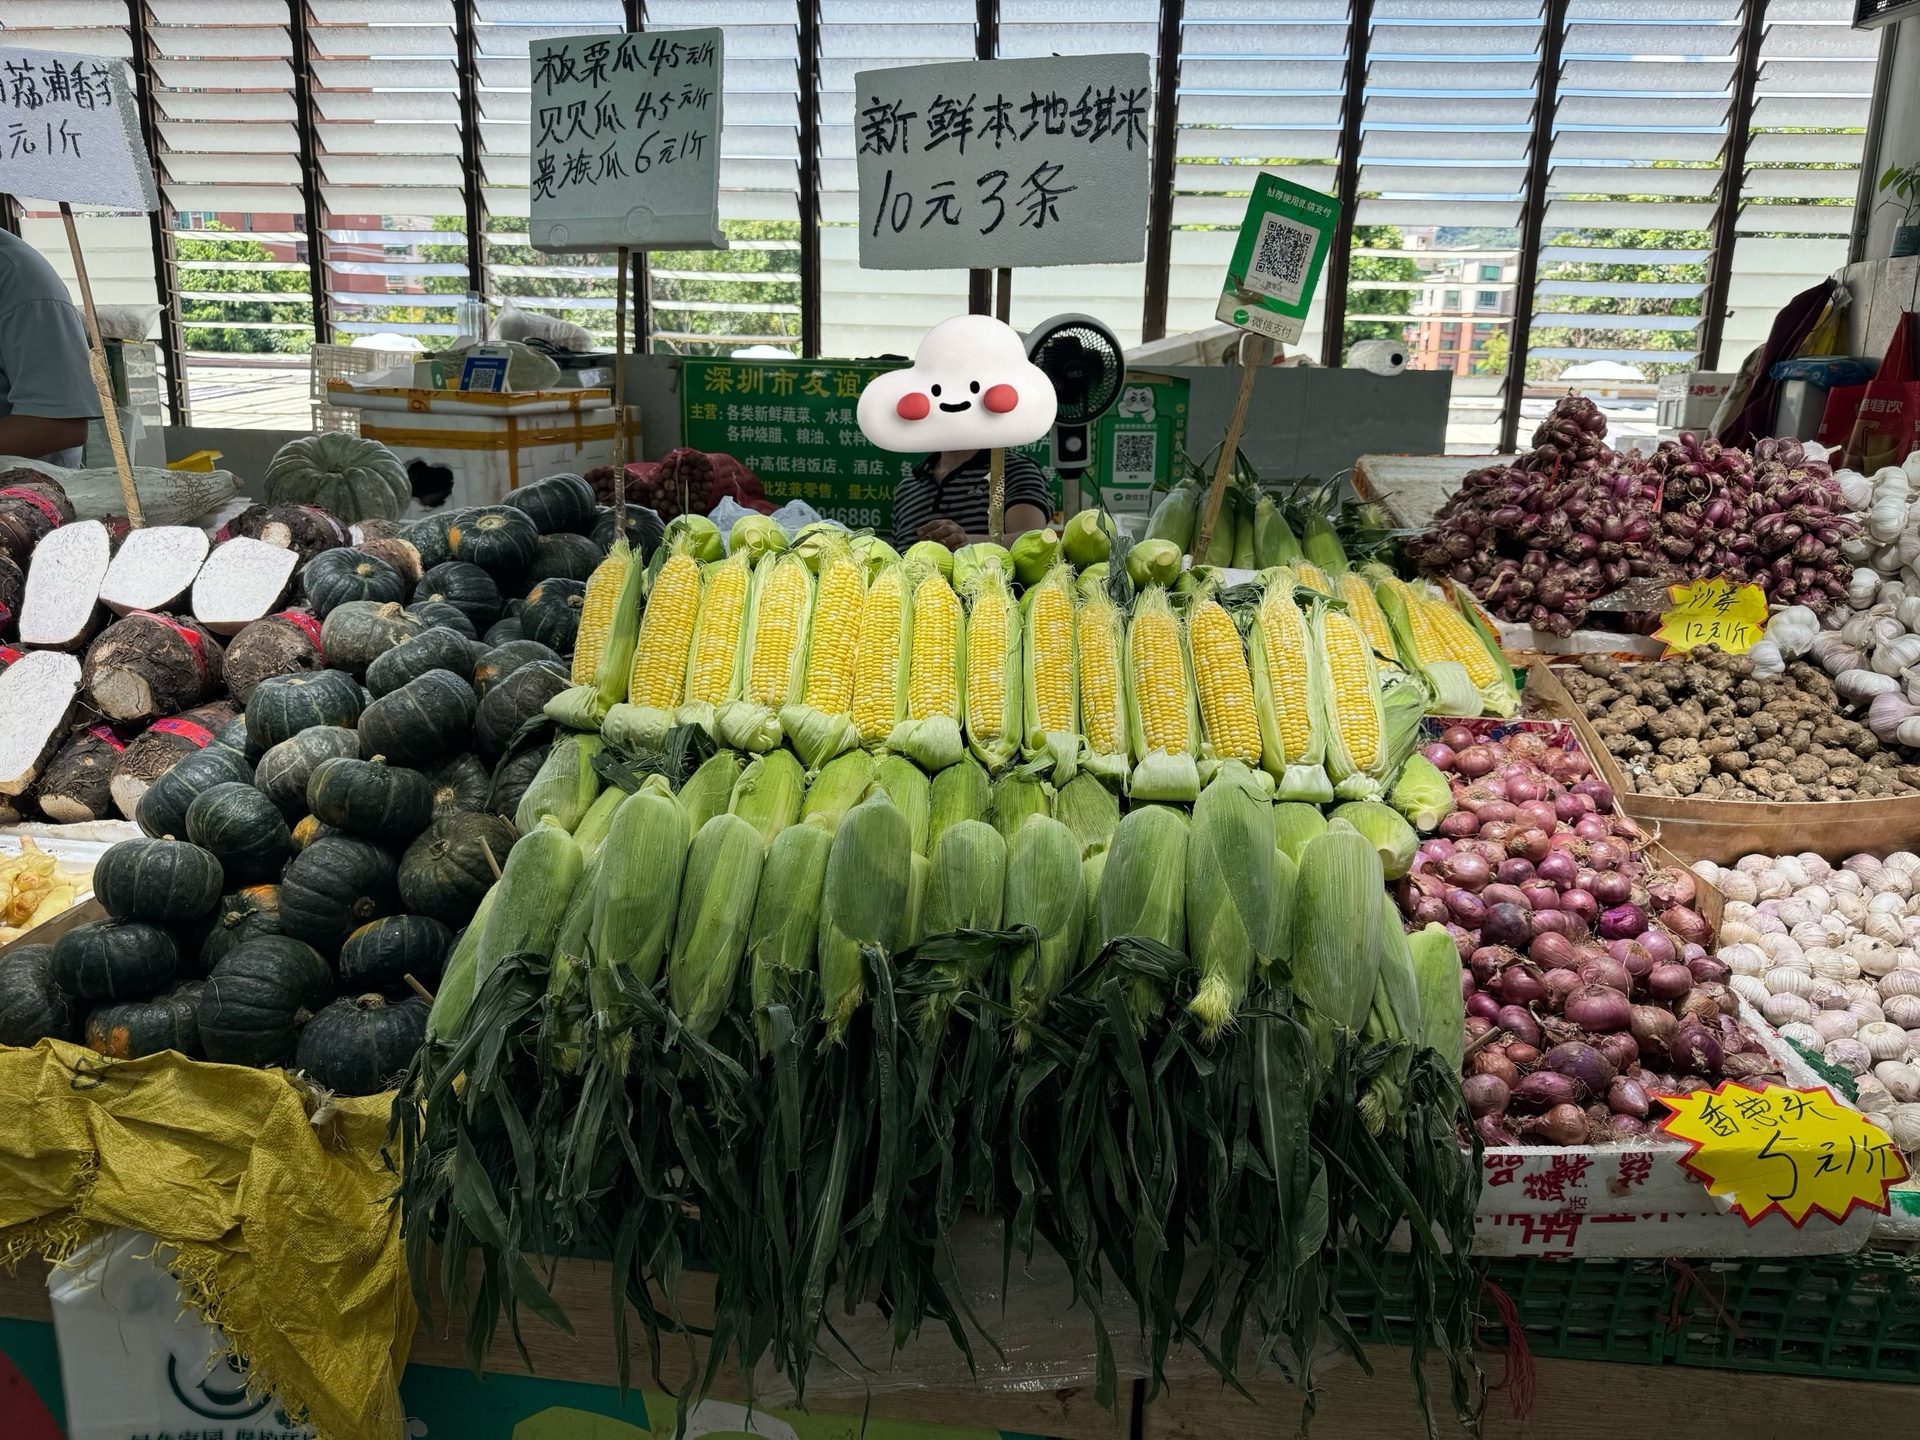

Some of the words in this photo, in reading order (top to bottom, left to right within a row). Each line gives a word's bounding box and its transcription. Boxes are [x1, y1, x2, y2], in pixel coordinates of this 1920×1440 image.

[0, 58, 111, 111] 荔浦香芋
[858, 85, 1149, 155] 新鲜本地甜米
[872, 160, 1078, 238] 10元3条
[1266, 186, 1333, 218] 推荐使用微信支付
[1251, 315, 1293, 339] 微信支付
[703, 366, 880, 399] 深圳市友谊
[761, 480, 898, 501] 批发兼零售，量大从
[1688, 586, 1741, 617] 沙姜
